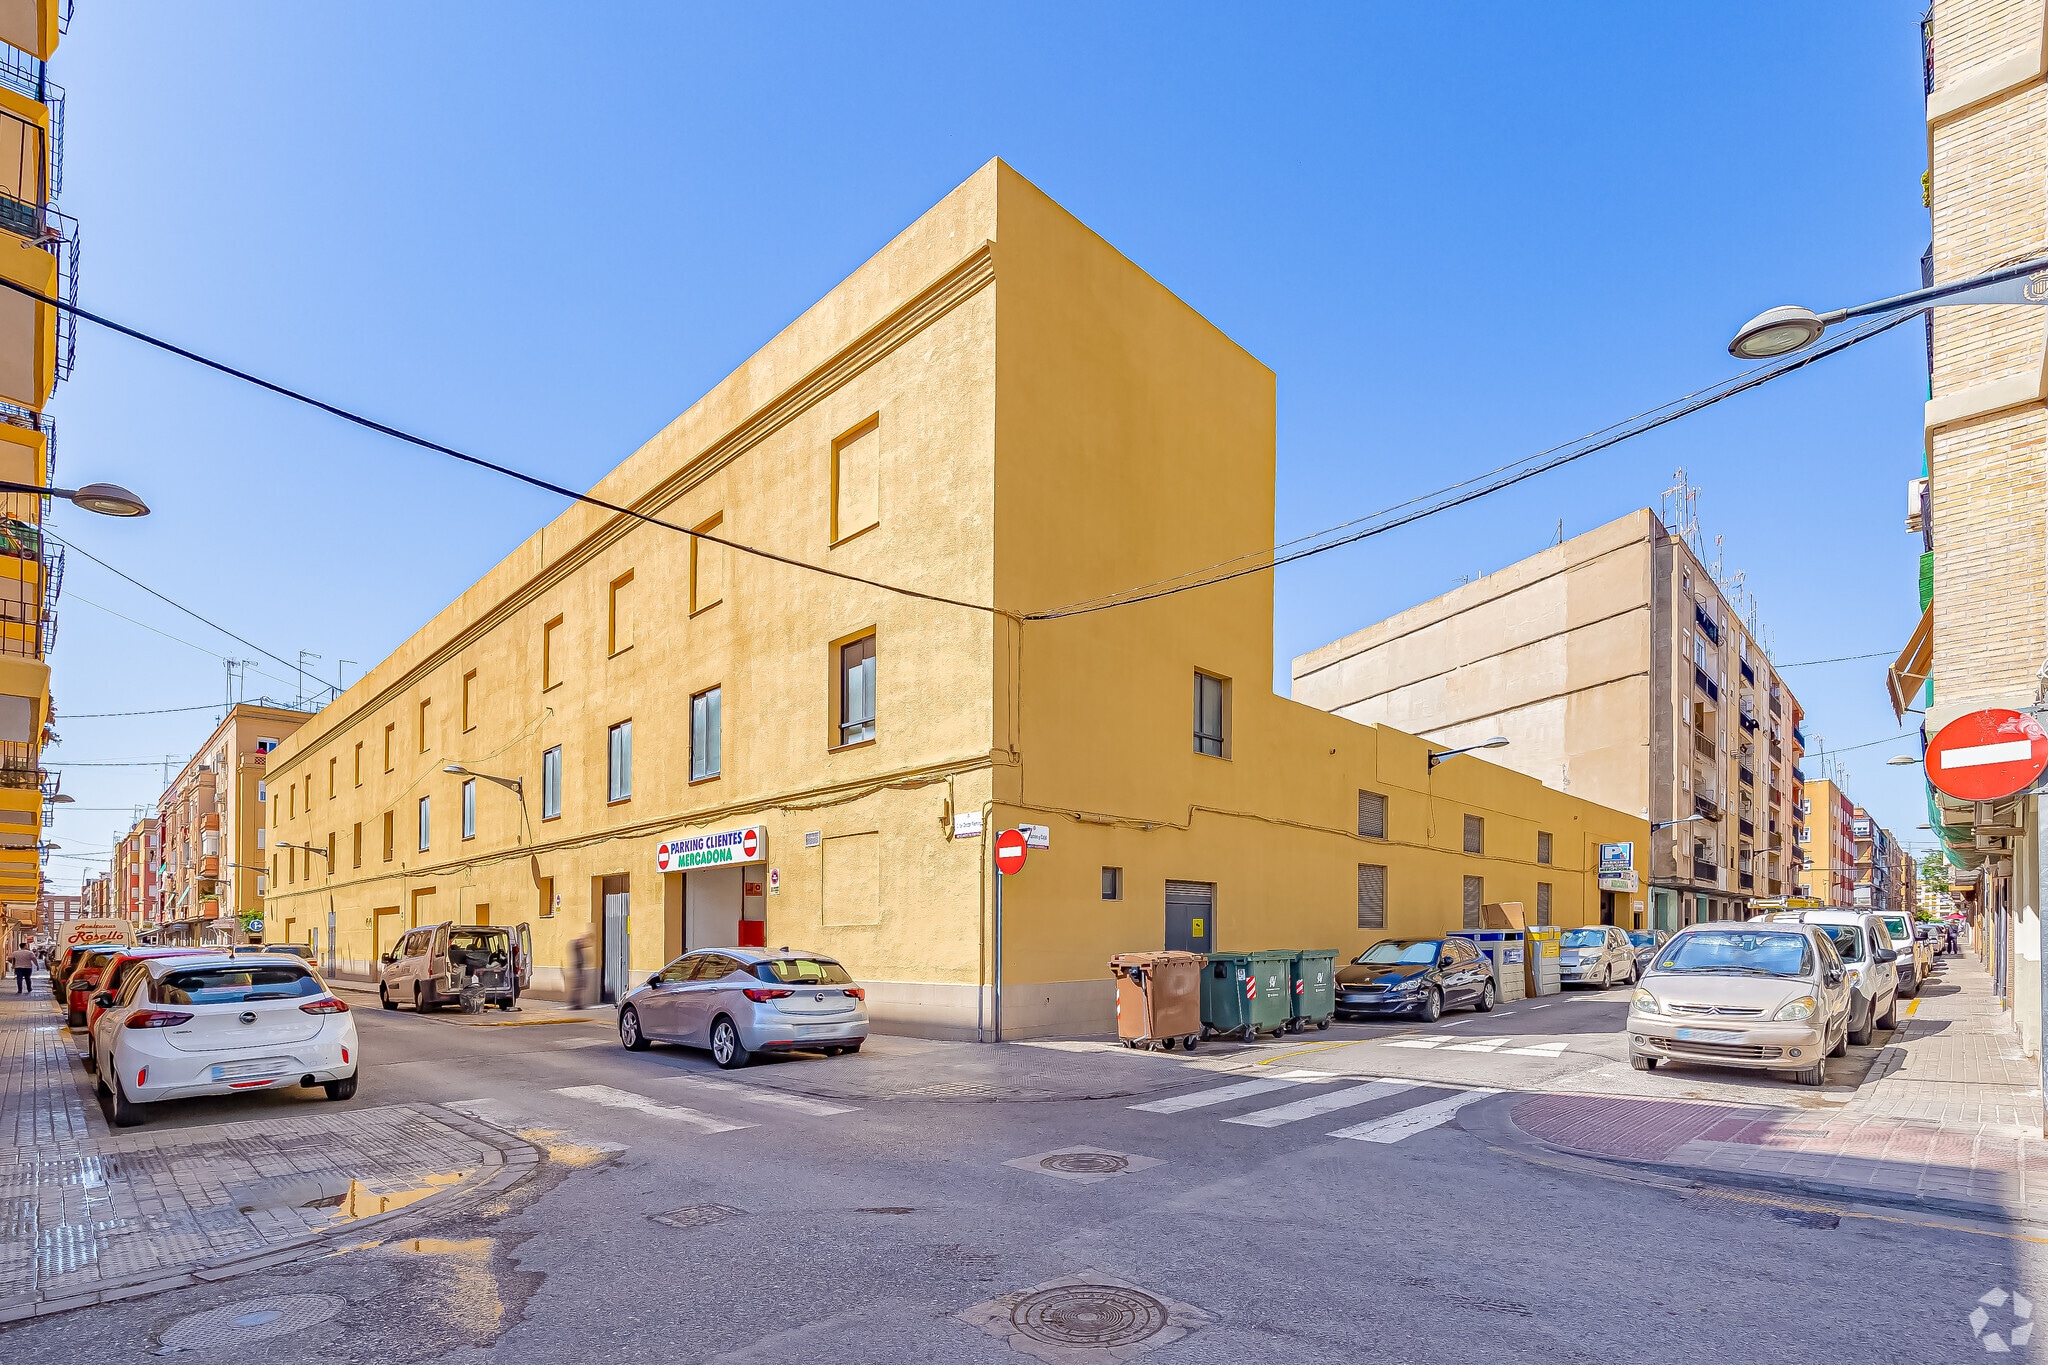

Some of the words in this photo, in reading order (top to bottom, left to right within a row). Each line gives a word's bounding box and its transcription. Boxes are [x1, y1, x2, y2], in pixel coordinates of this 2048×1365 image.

[671, 838, 704, 854] PARKING
[706, 831, 743, 849] CLIENTES
[678, 848, 733, 868] MERCADONA
